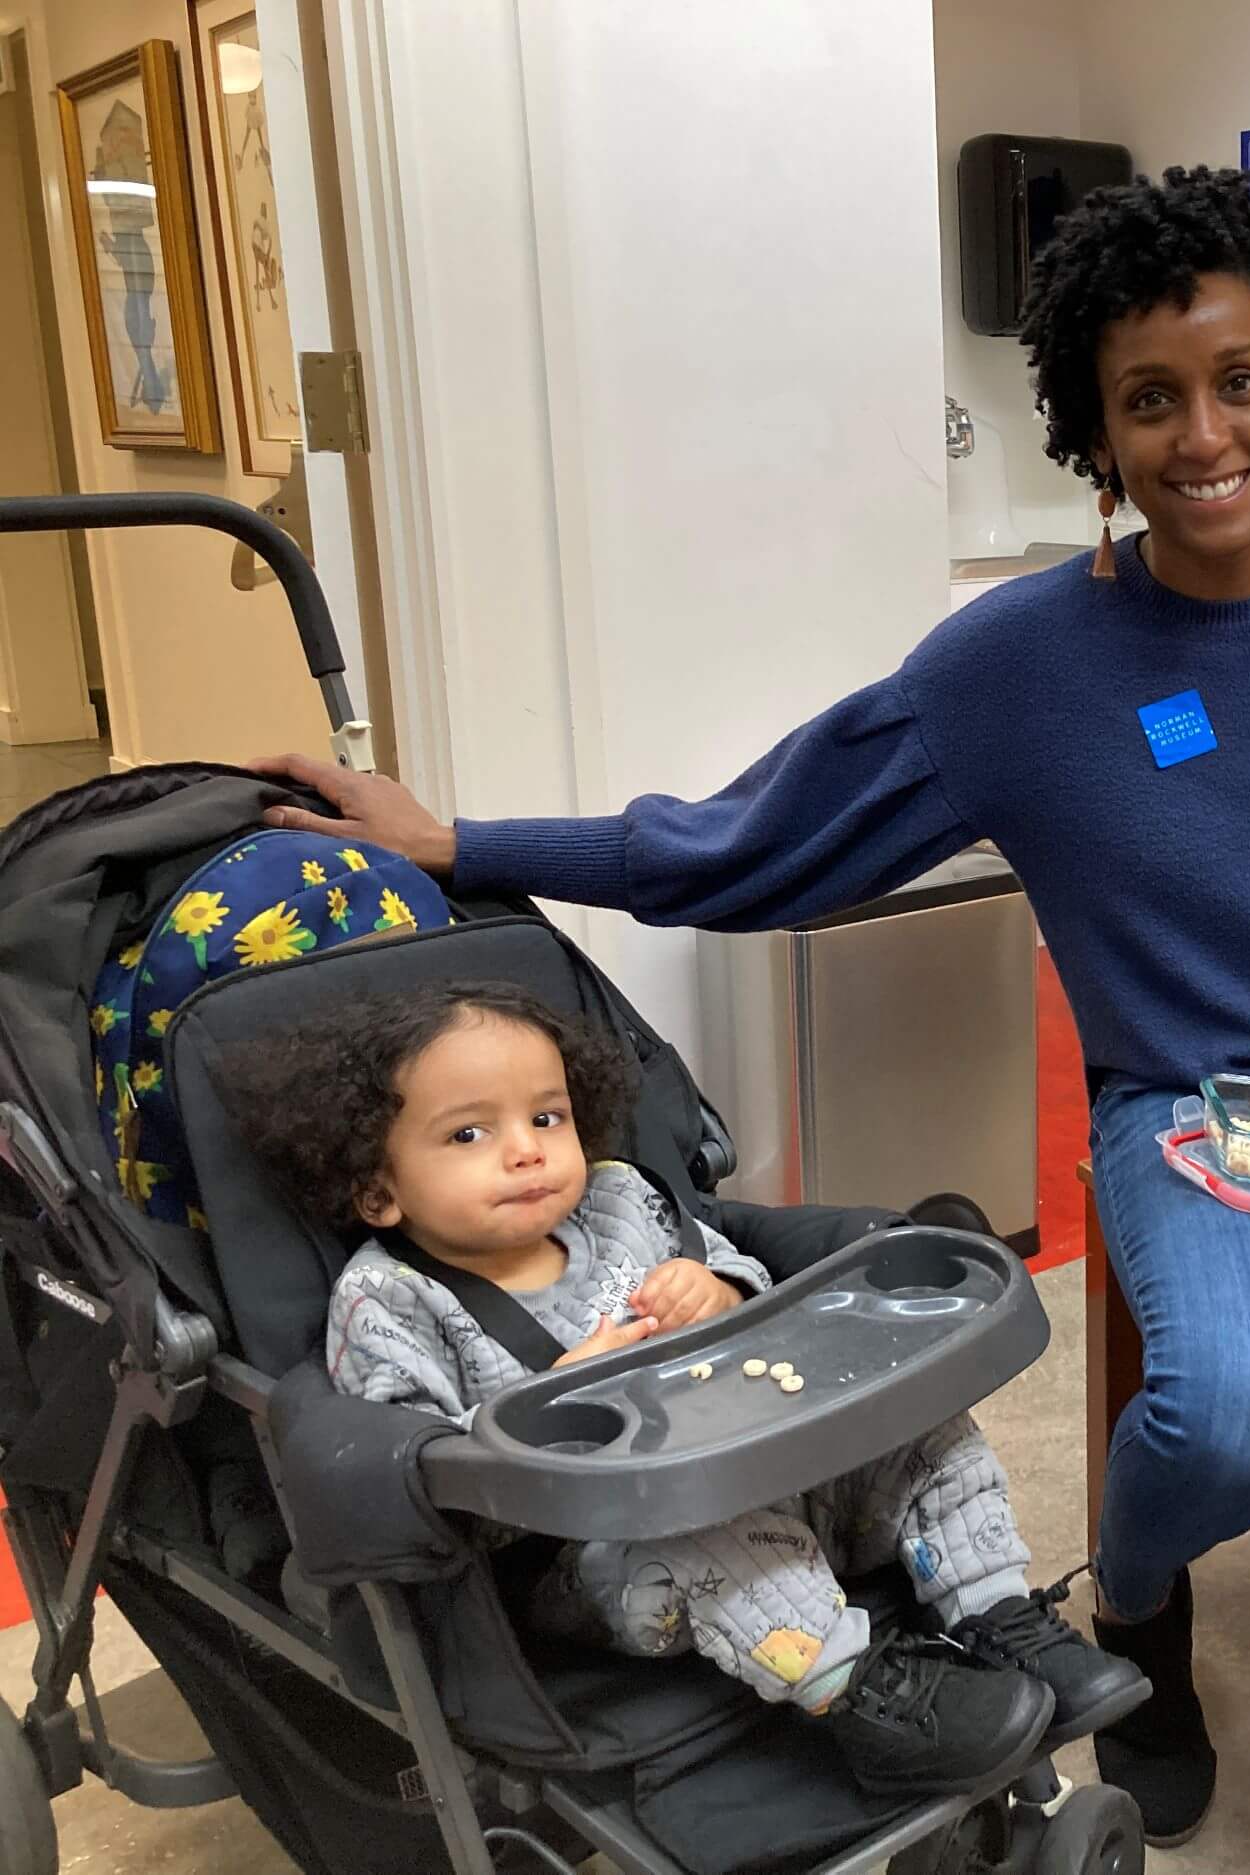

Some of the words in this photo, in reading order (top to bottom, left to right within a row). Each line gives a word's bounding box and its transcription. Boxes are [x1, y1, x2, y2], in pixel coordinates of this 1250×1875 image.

[1150, 717, 1204, 740] ROCKWELL
[1154, 711, 1195, 729] NORMAN
[1160, 727, 1201, 746] MUSEUM
[37, 1272, 96, 1318] Caboose
